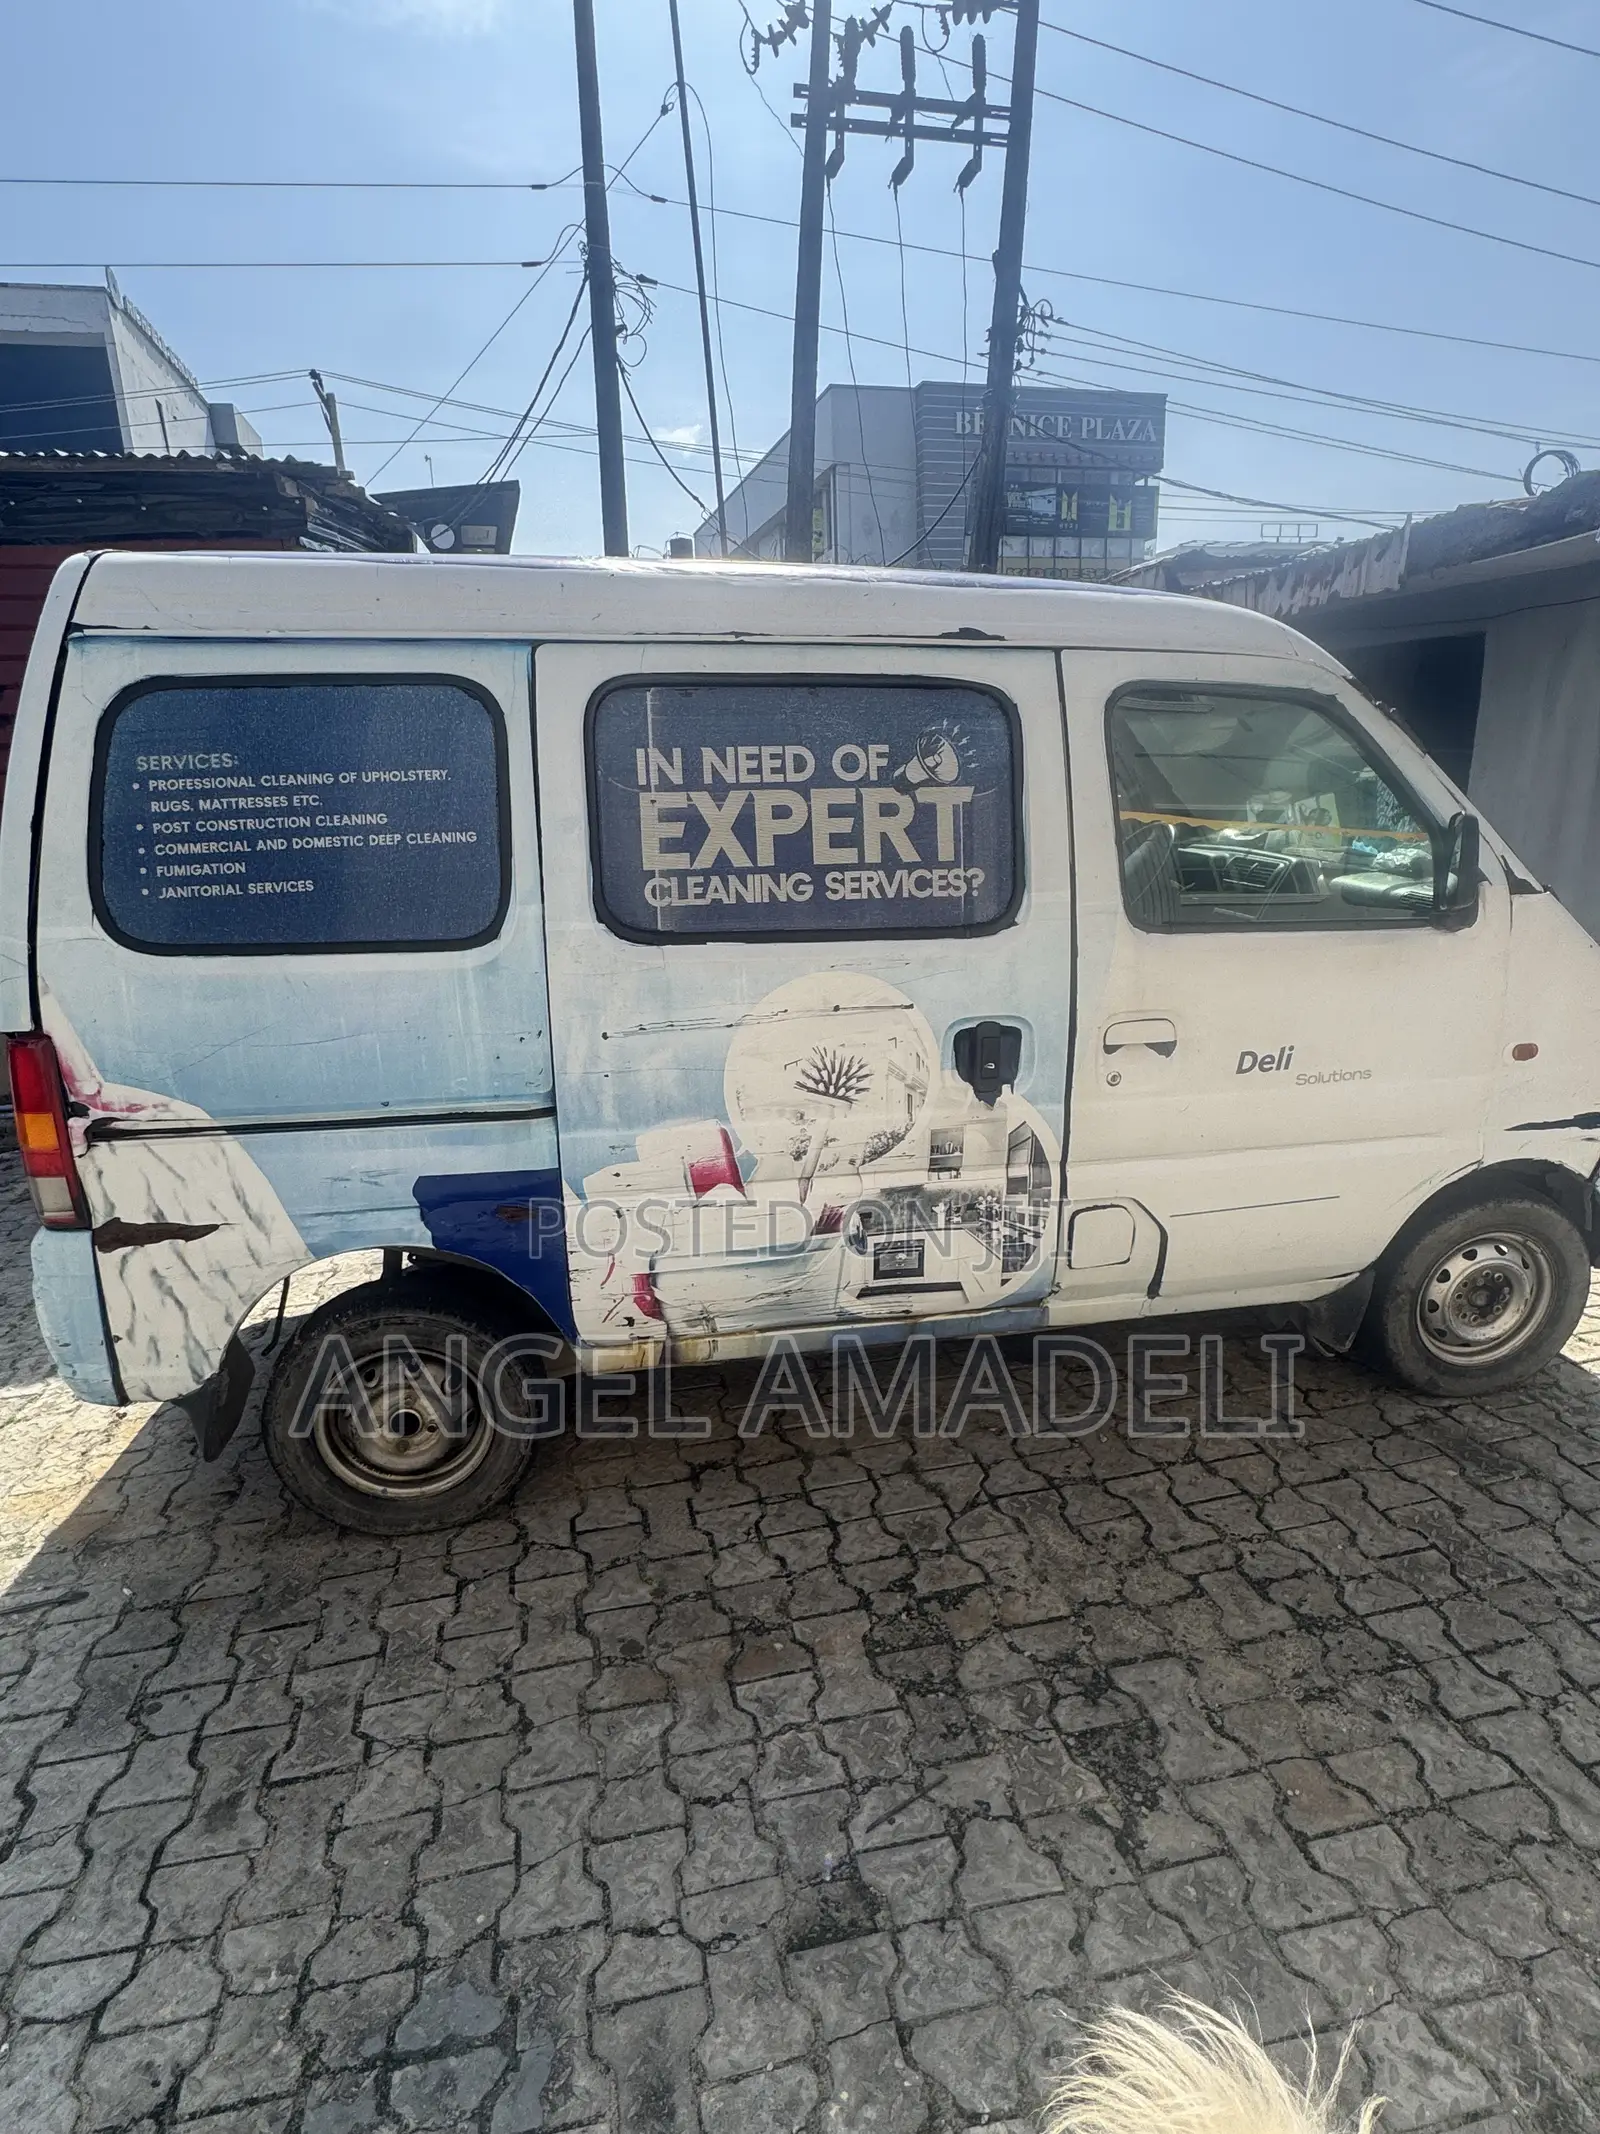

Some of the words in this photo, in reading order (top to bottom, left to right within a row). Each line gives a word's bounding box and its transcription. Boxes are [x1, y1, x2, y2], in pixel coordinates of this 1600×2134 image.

[954, 411, 1072, 439] BENICE
[1080, 415, 1157, 442] PLAZA
[636, 746, 684, 786] IN
[701, 744, 816, 784] NEED
[831, 744, 889, 781] OF
[148, 775, 256, 792] PROFESSIONAL
[260, 772, 334, 787] CLEANING
[338, 771, 358, 785] OF
[199, 795, 289, 811] MATTRESSES
[292, 794, 324, 807] ETC.
[152, 821, 191, 835] POST
[195, 815, 312, 832] CONSTRUCTION
[315, 812, 389, 827] CLEANING
[639, 785, 975, 871] EXPERT
[154, 840, 252, 856] COMMERCIAL
[256, 838, 288, 851] AND
[291, 834, 365, 849] DOMESTIC
[368, 833, 402, 846] DEEP
[406, 830, 478, 845] CLEANING
[156, 861, 247, 878] FUMIGATION
[158, 883, 244, 900] JANITORIAL
[248, 879, 315, 895] SERVICES
[644, 873, 815, 907] CLEANING
[825, 867, 986, 900] SERVICES?
[1235, 1045, 1295, 1075] Deli
[1295, 1067, 1372, 1086] Solutions
